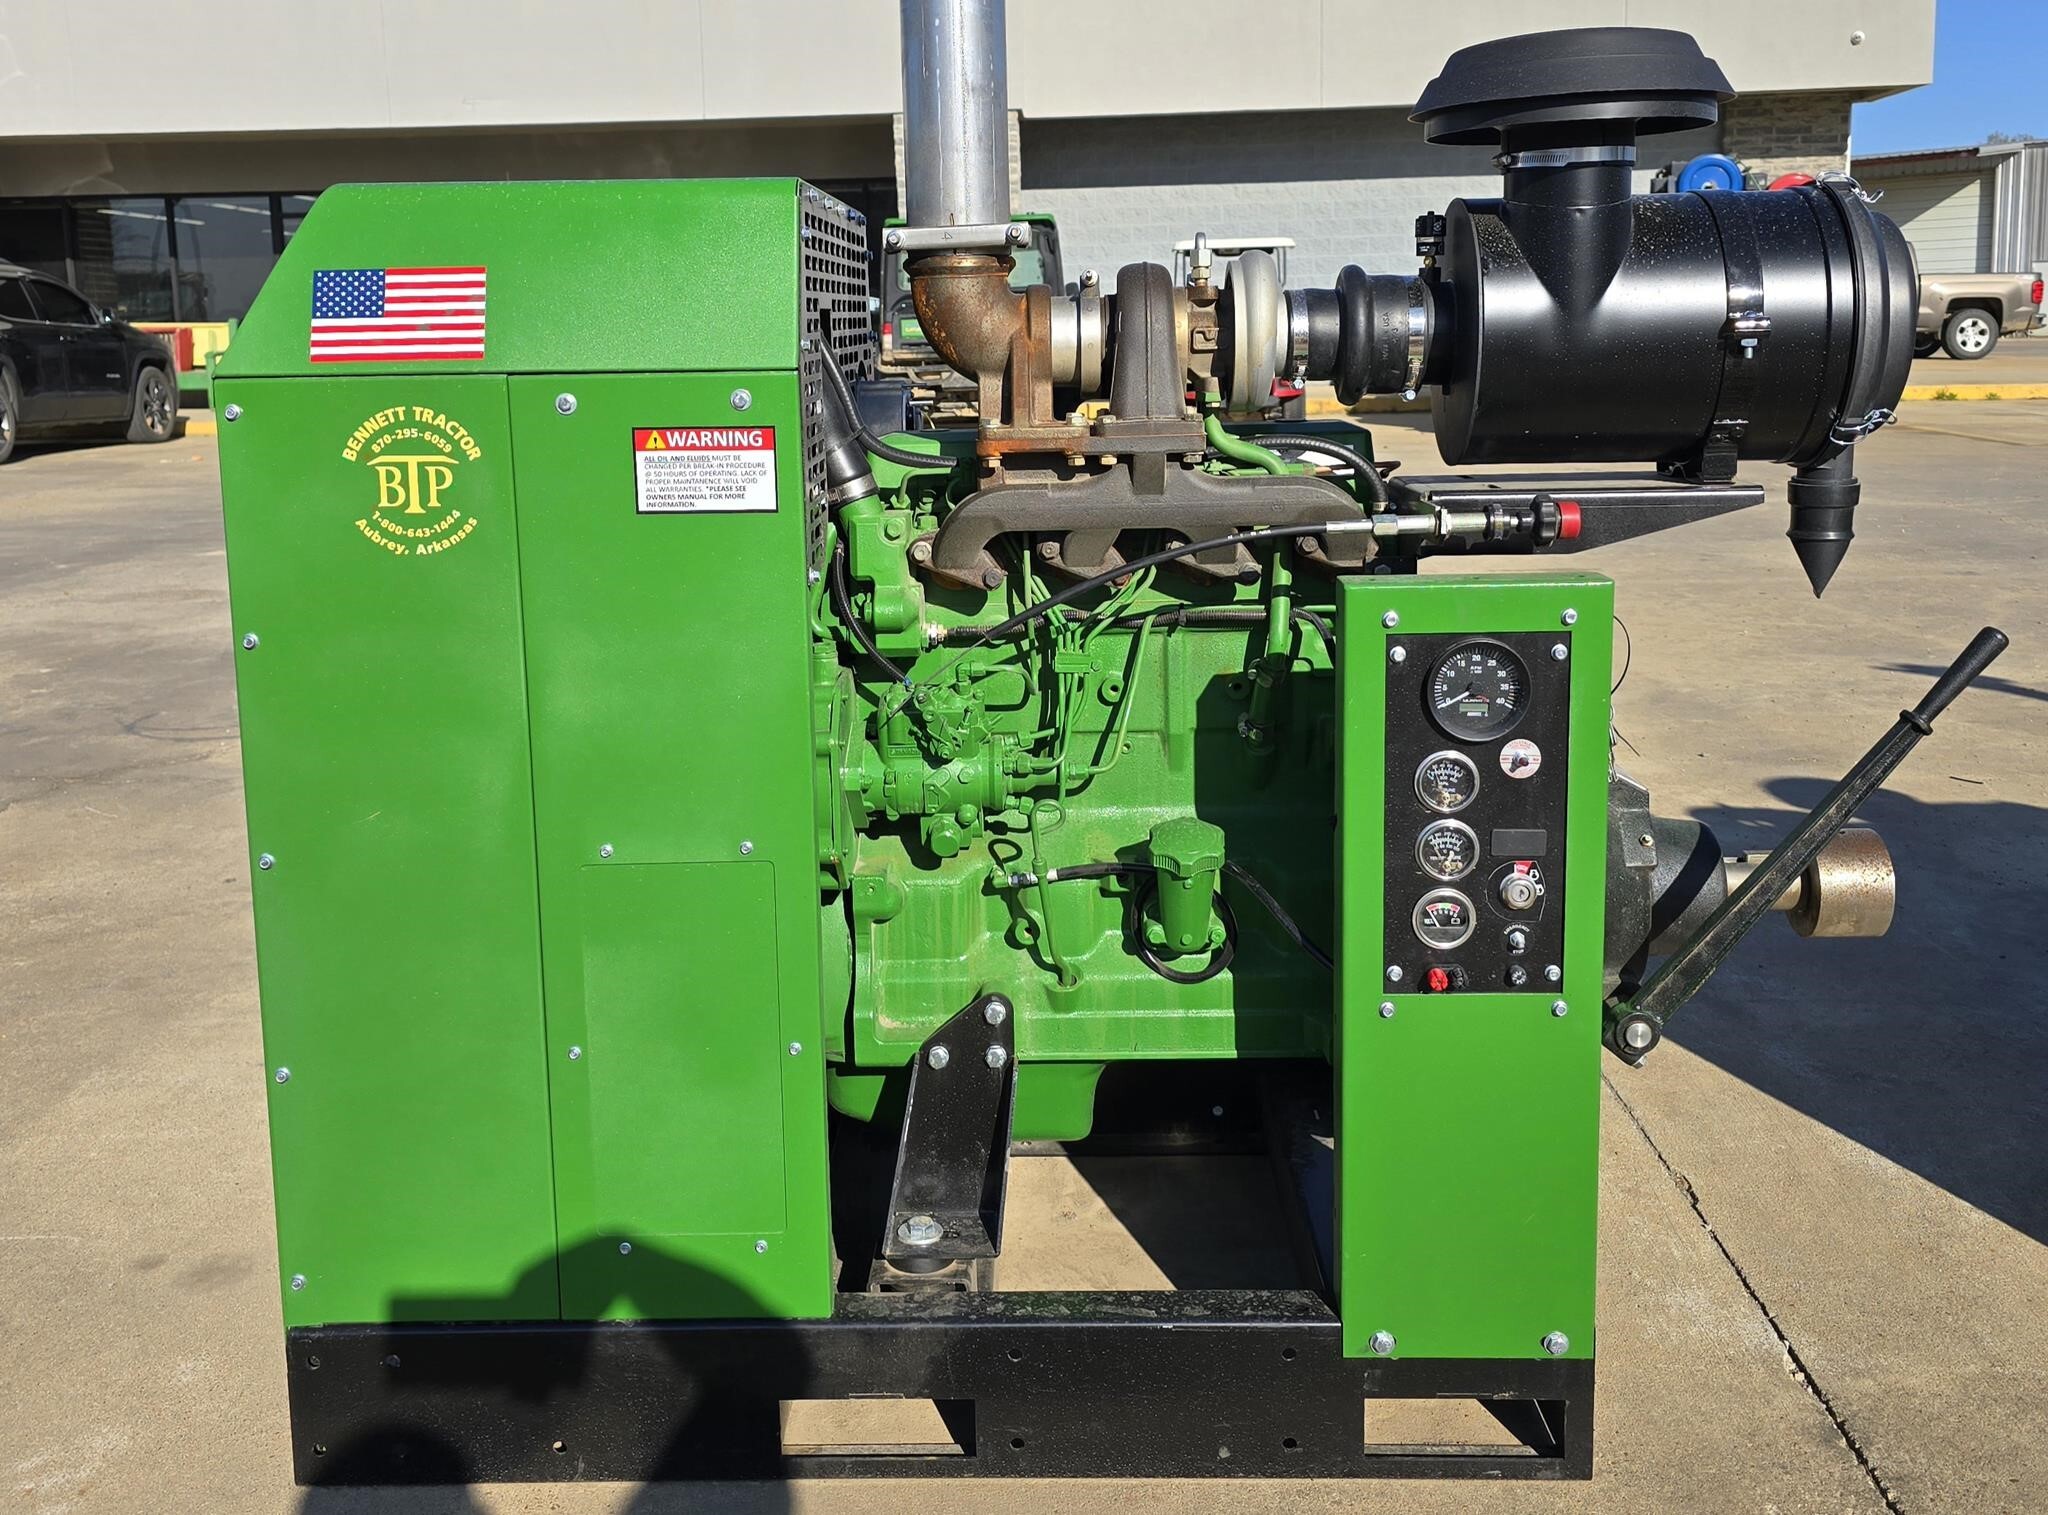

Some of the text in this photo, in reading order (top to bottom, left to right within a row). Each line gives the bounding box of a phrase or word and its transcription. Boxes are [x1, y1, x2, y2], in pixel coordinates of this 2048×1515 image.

[342, 406, 481, 462] BENNETT TRACTOR
[371, 428, 452, 453] 870-295-6059
[666, 430, 763, 447] WARNING
[355, 517, 477, 555] Aubrey, Arkansas
[372, 509, 461, 537] 1-800-643-1444
